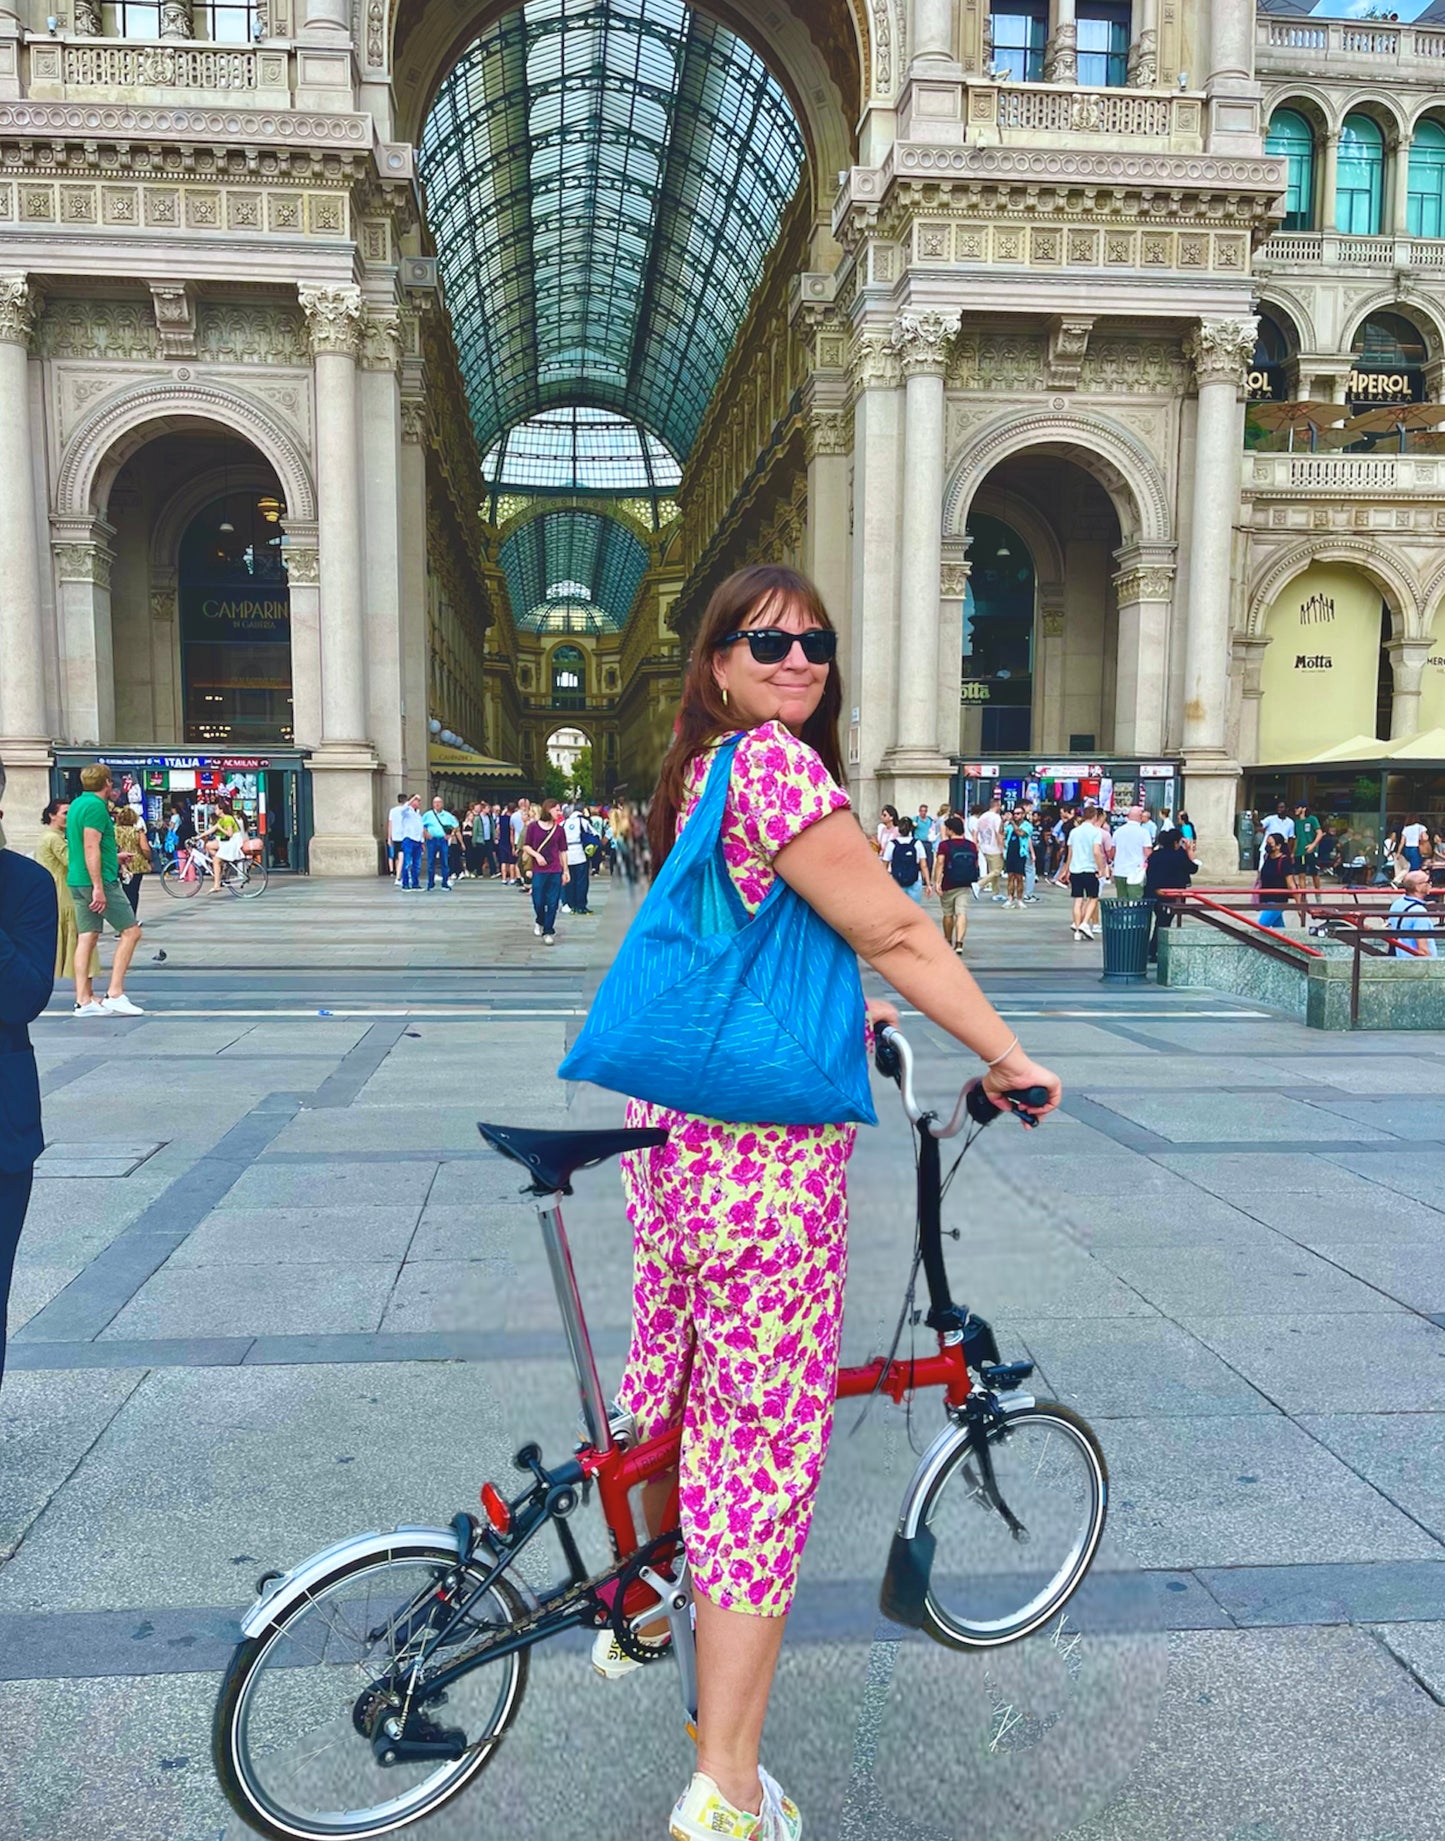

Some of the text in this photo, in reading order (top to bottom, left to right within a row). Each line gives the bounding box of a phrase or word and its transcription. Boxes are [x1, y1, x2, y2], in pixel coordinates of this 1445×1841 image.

[1349, 370, 1412, 394] APEROL
[1294, 655, 1333, 669] Motta
[164, 758, 200, 768] ITALIA
